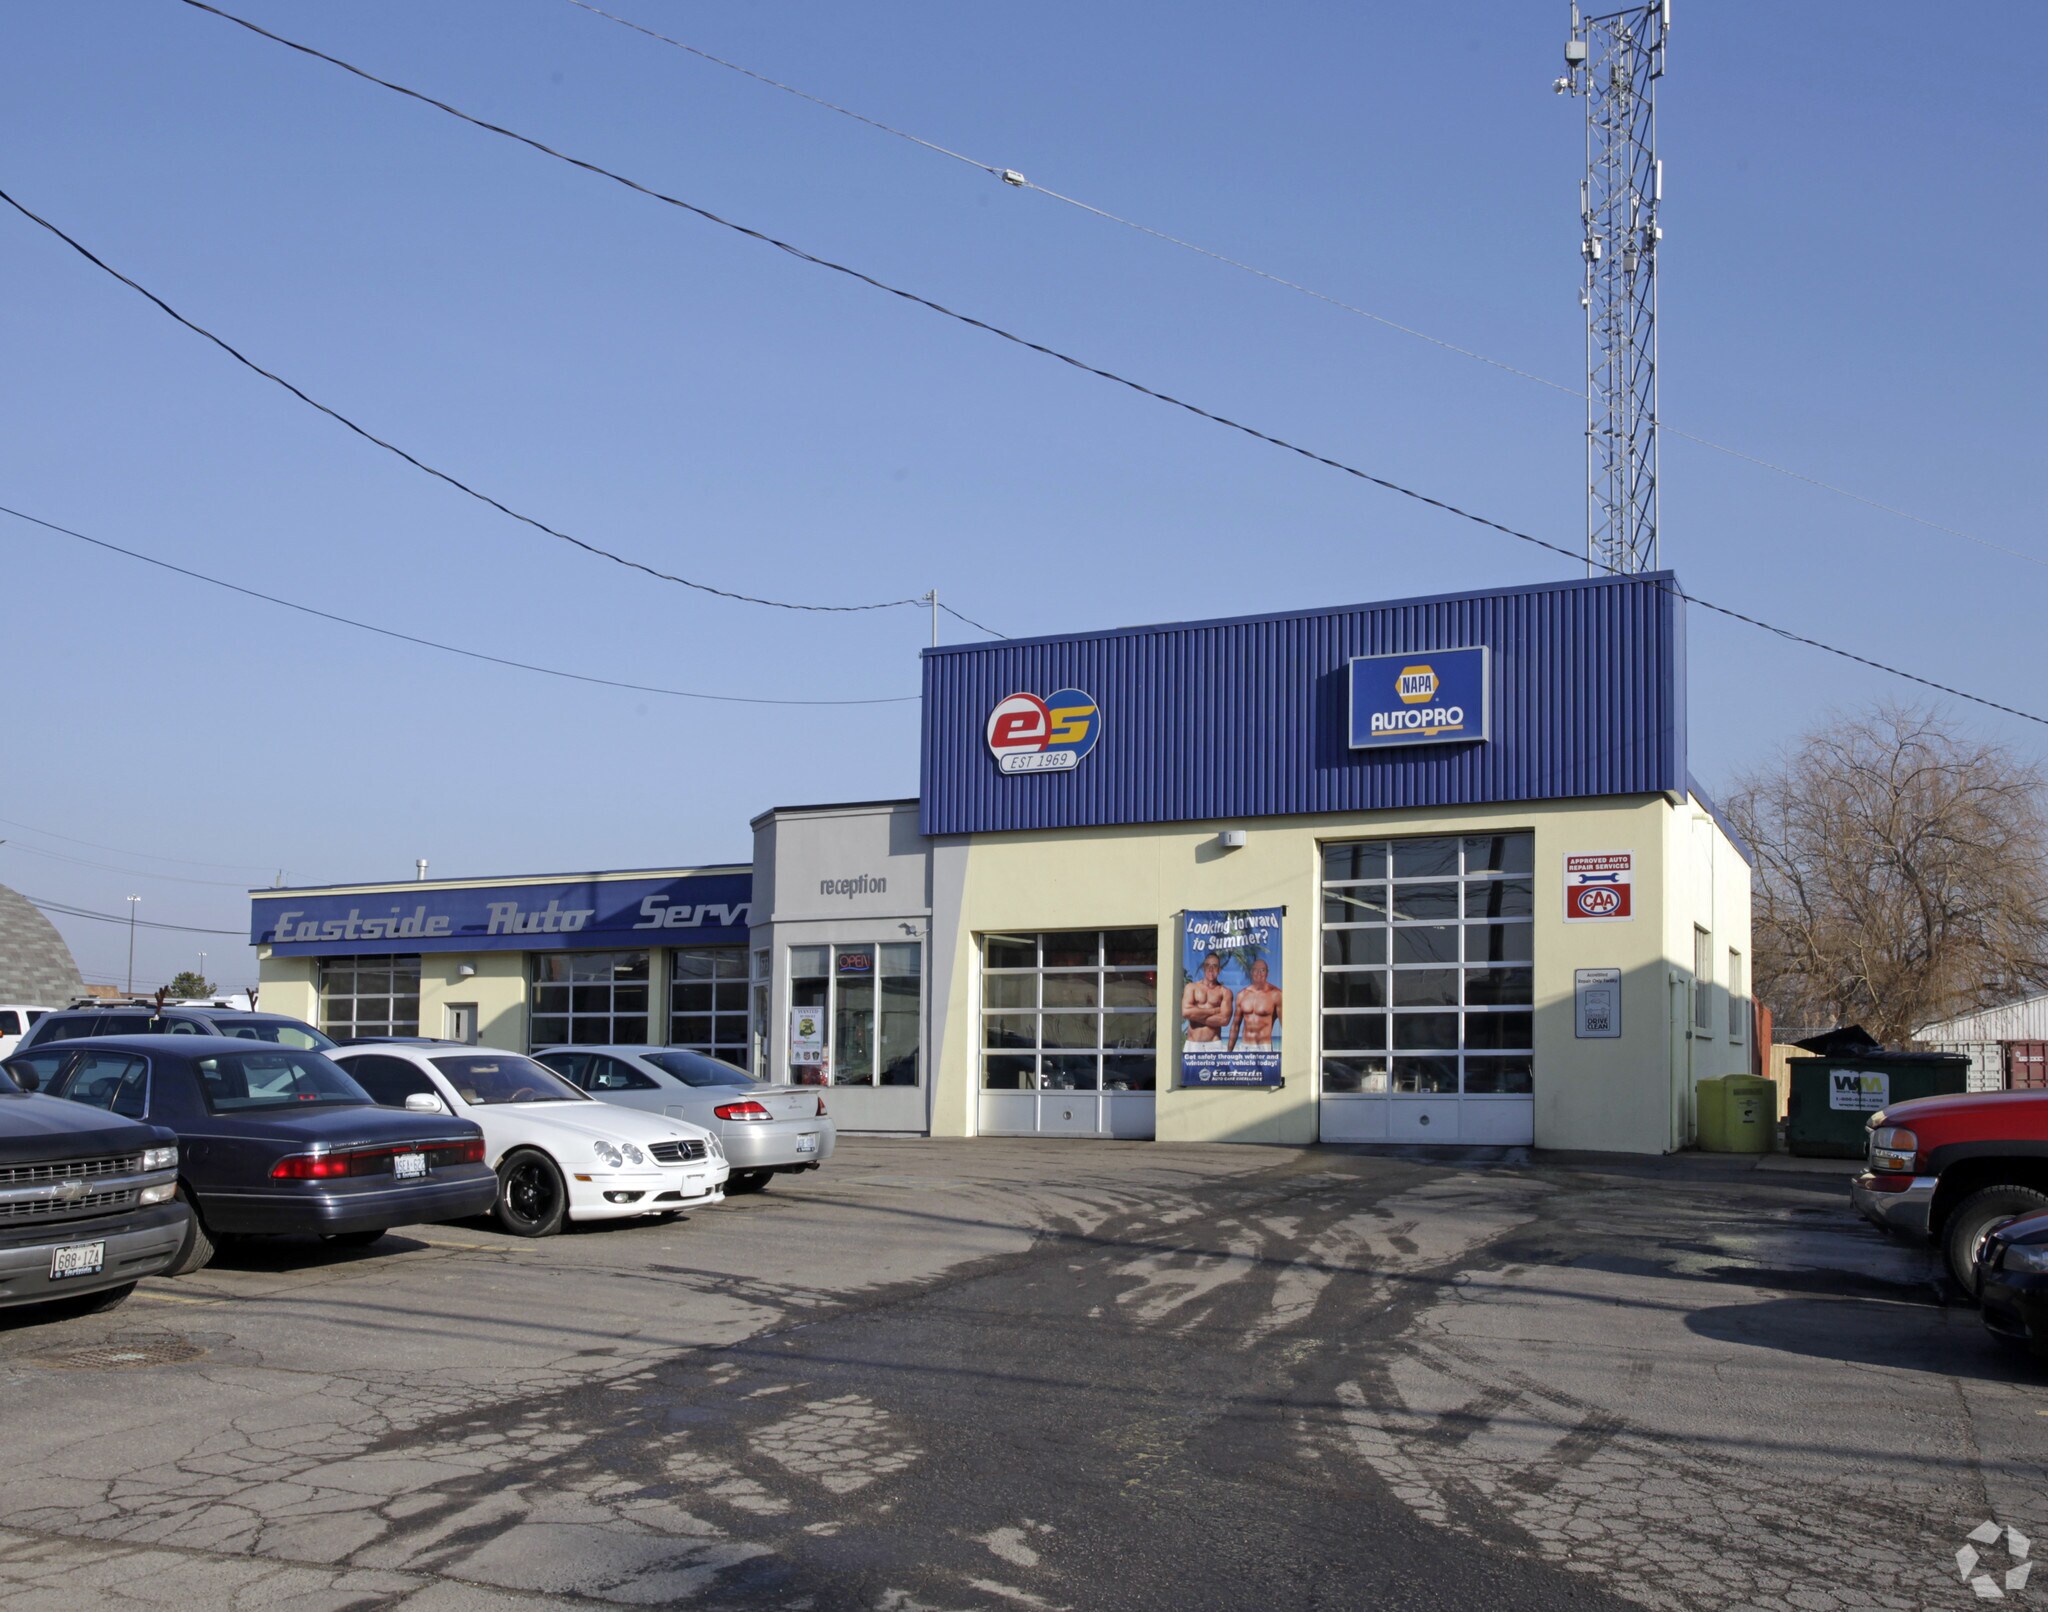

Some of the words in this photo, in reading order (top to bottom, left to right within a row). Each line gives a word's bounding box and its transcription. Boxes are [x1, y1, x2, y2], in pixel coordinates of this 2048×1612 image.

[1403, 675, 1432, 694] NAPA
[1371, 706, 1464, 731] AUTOPRO
[1011, 755, 1034, 769] EST
[1037, 753, 1068, 767] 1969
[820, 874, 887, 900] reception
[1583, 891, 1614, 911] CAA
[273, 905, 452, 942] Eastside
[486, 900, 595, 935] Auto
[1187, 915, 1230, 935] Looking
[1234, 913, 1279, 930] forward
[1192, 937, 1206, 951] to
[1208, 929, 1268, 950] Summer?
[839, 954, 871, 968] OPEN
[1198, 1053, 1217, 1061] safely
[1218, 1053, 1243, 1061] through
